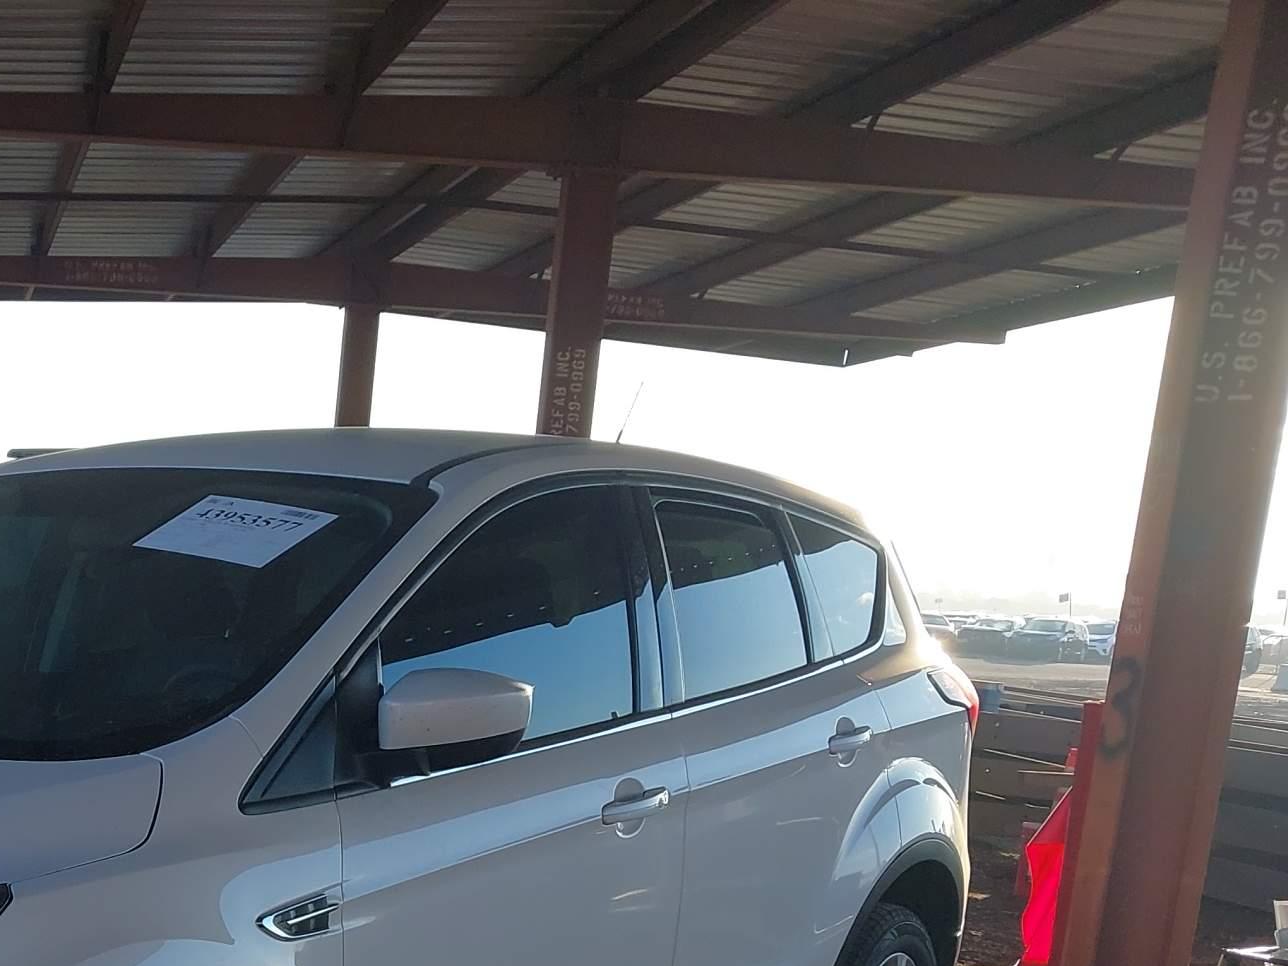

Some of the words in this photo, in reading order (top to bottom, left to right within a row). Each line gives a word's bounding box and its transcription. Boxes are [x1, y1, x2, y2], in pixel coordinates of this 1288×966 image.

[1237, 97, 1278, 165] INC.
[1209, 184, 1260, 320] PREFAB
[1194, 341, 1231, 404] U.S.
[195, 508, 304, 532] 43953577
